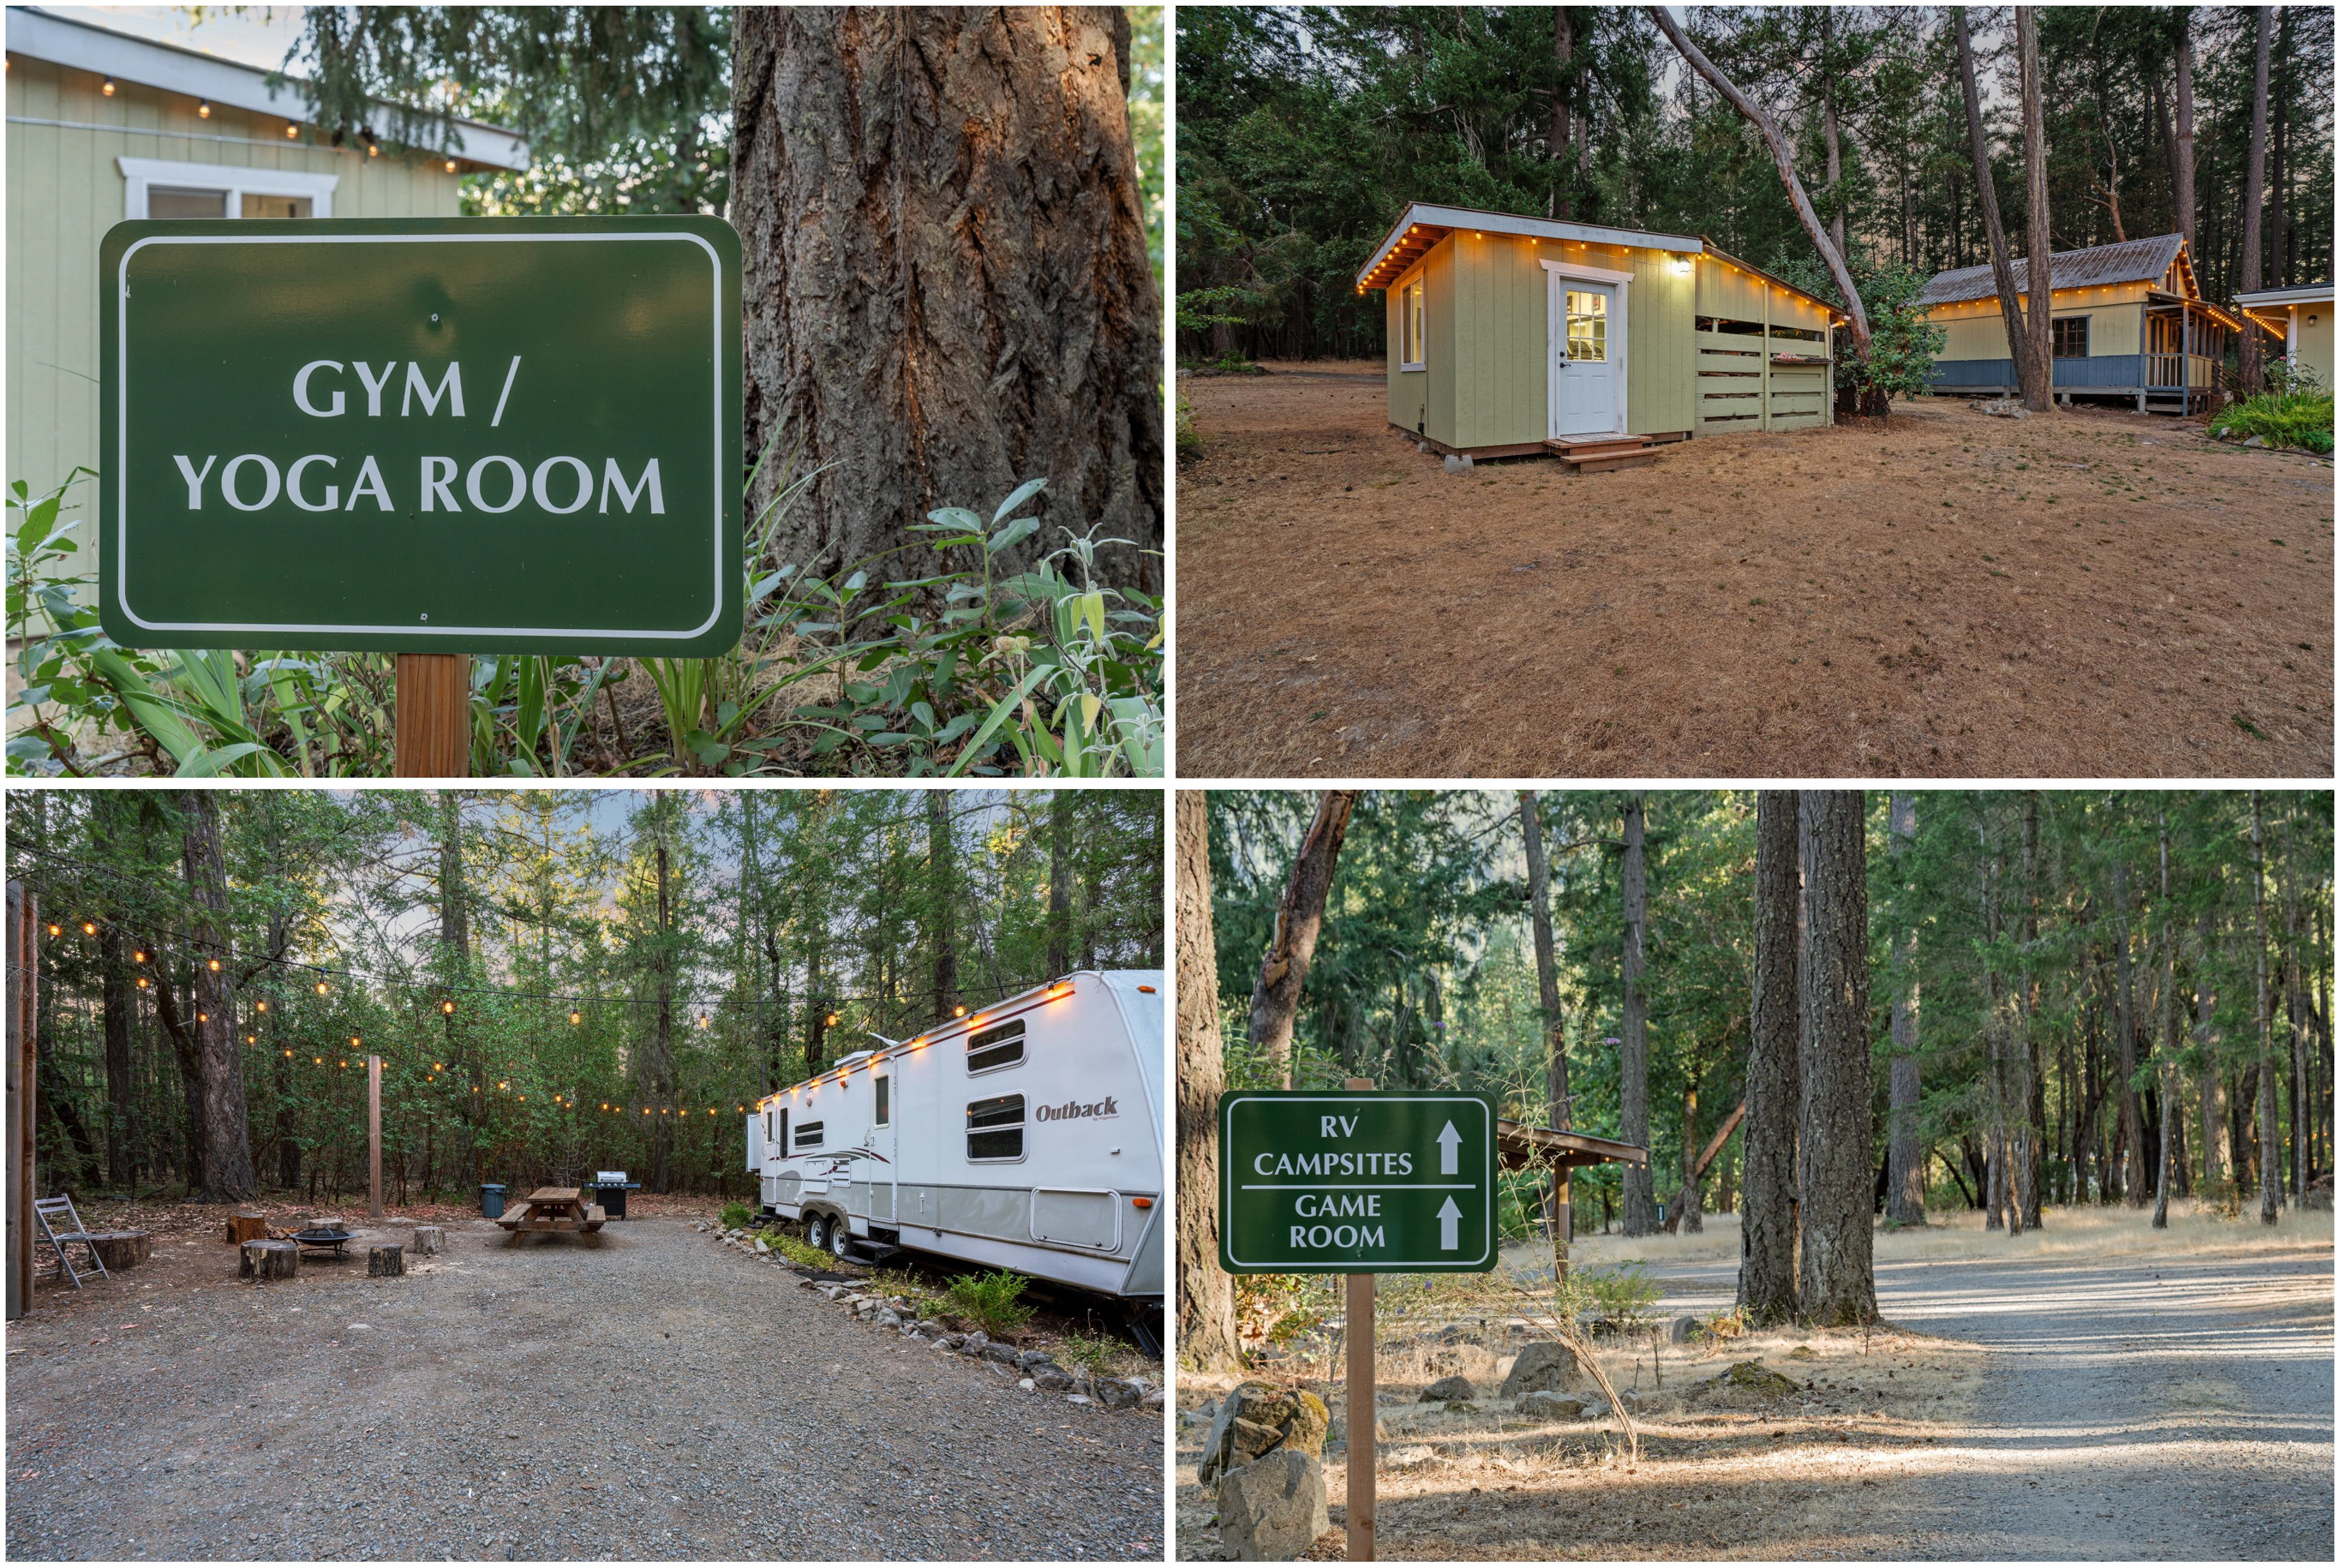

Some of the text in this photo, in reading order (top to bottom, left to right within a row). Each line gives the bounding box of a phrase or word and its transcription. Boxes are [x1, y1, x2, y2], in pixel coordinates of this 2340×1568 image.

[293, 356, 522, 427] GYM /
[173, 454, 666, 514] YOGA ROOM
[1035, 1095, 1118, 1122] Outback
[1321, 1116, 1359, 1138] RV
[1254, 1152, 1413, 1176] CAMPSITES
[1295, 1194, 1381, 1218] GAME
[1290, 1225, 1385, 1248] ROOM
